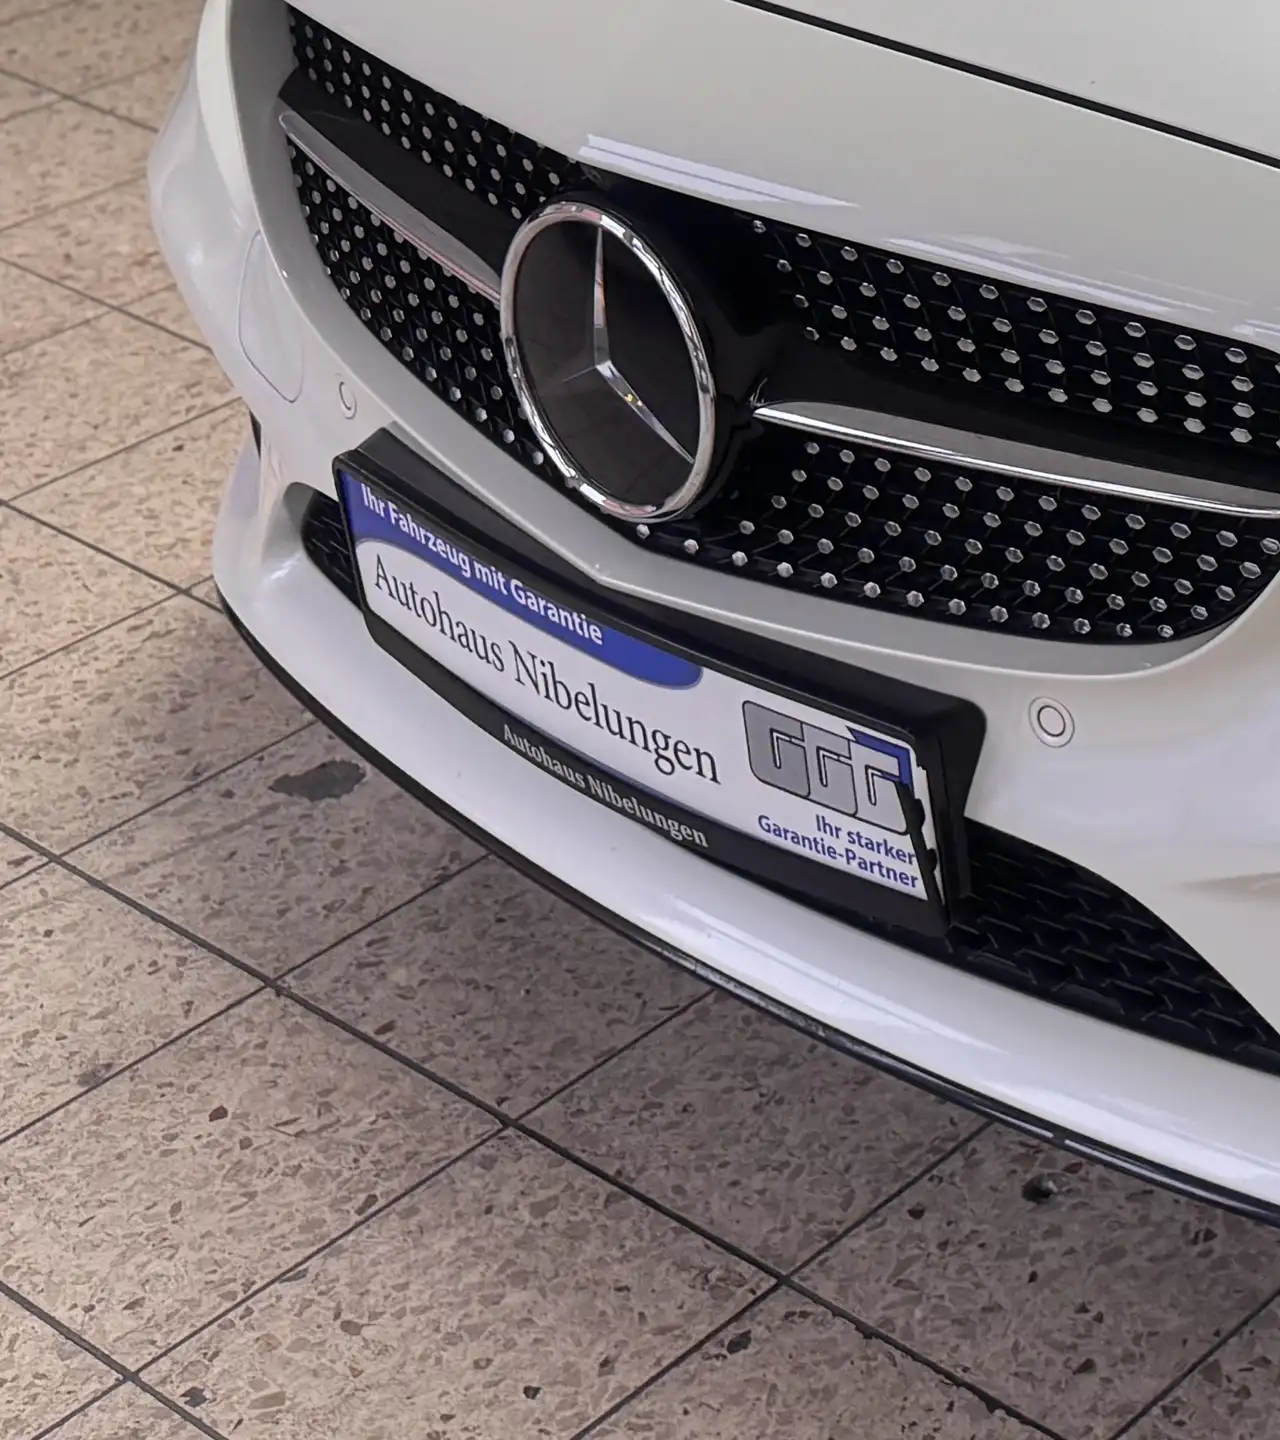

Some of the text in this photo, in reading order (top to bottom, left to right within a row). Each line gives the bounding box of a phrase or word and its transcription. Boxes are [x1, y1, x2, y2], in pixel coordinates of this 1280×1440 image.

[360, 483, 603, 645] Ihr Fahrzeug mit Garantie
[374, 554, 722, 785] Autohaus Nibelungen
[503, 724, 709, 848] Autohaus Nibelungen
[815, 814, 916, 866] Ihr starker
[757, 814, 919, 889] Garantie-Partner
